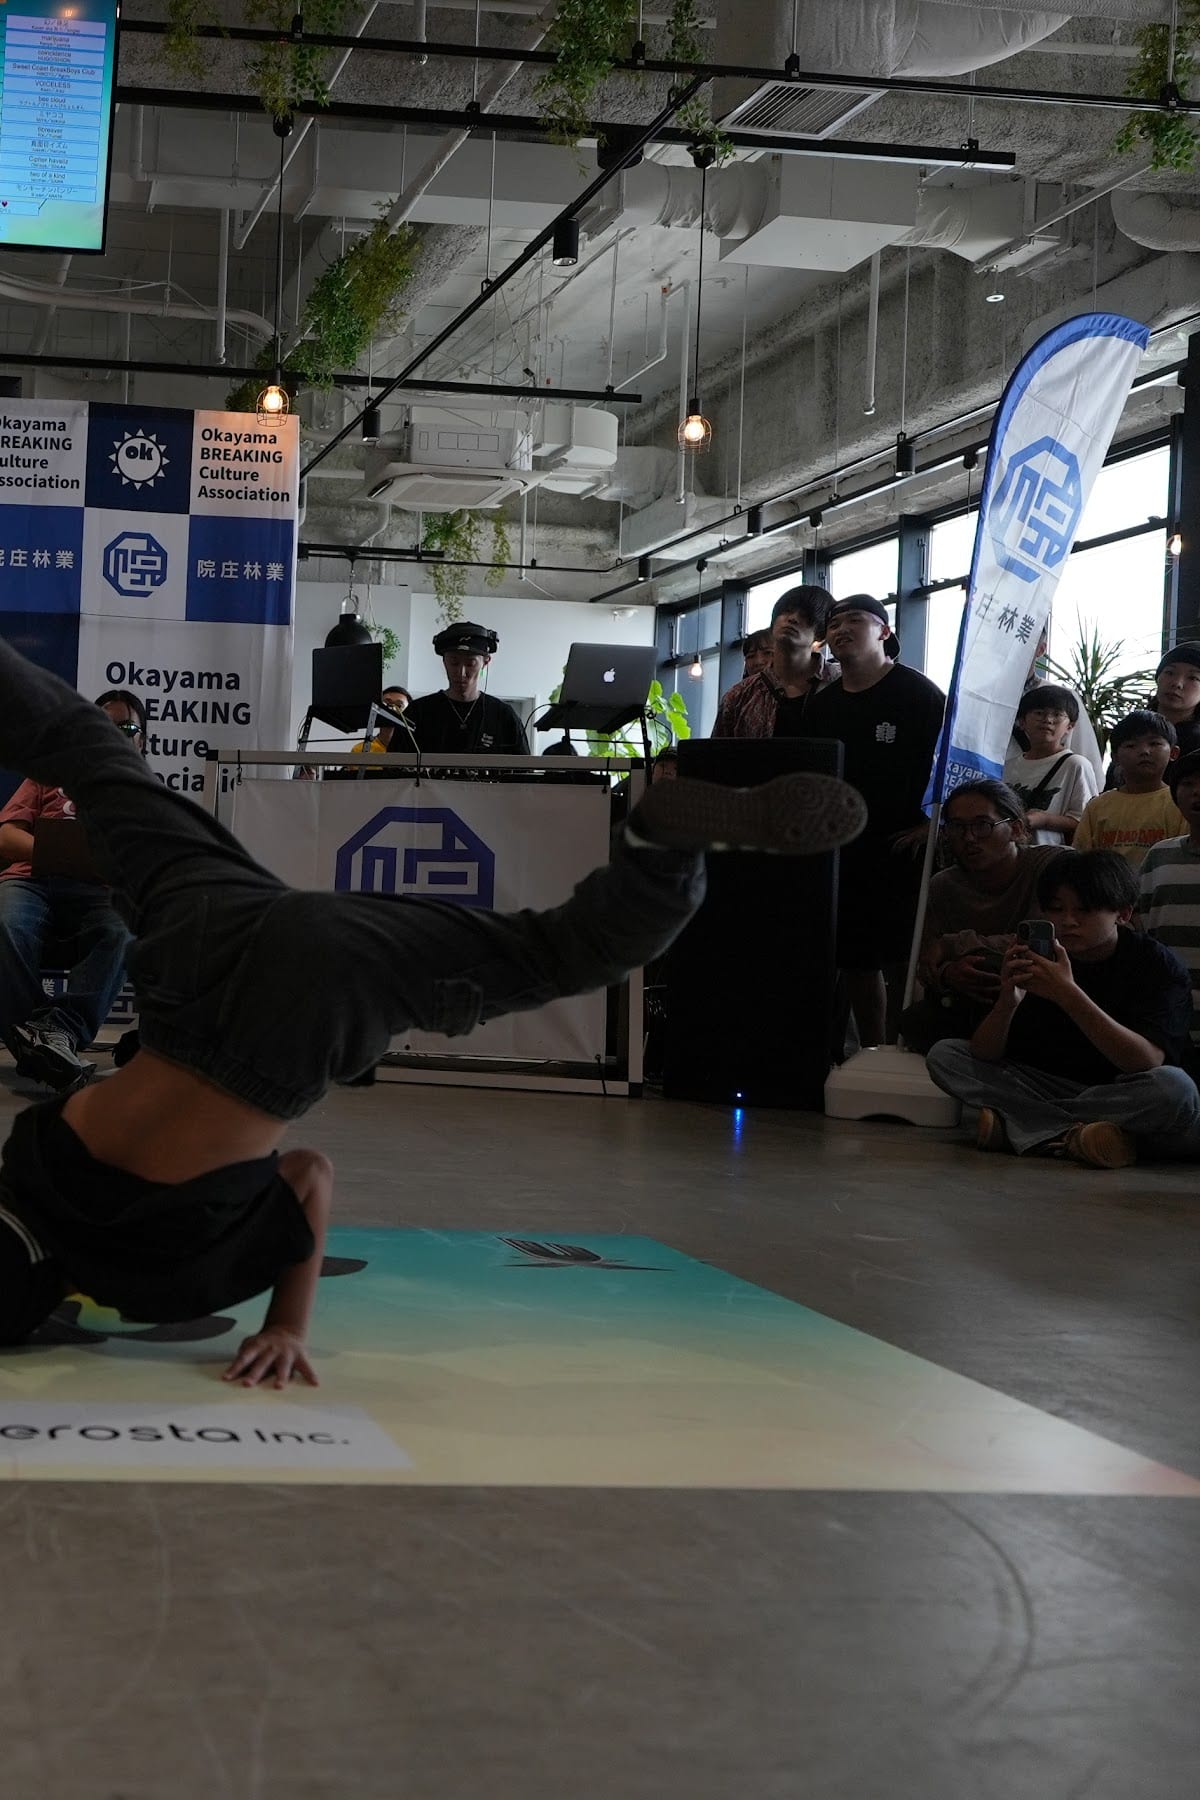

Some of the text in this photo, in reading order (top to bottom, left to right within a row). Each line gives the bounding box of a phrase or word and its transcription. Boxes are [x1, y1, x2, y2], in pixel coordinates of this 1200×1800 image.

[35, 80, 71, 88] VOICELESS
[201, 428, 278, 446] Okayama
[200, 447, 283, 464] BREAKING
[199, 466, 260, 483] Culture
[197, 485, 291, 503] Association
[197, 559, 285, 582] 院庄林業
[972, 587, 1036, 645] 庄林業
[105, 661, 240, 693] Okayama
[146, 698, 251, 726] EAKING
[144, 731, 210, 758] ture
[254, 1427, 351, 1446] Inc.
